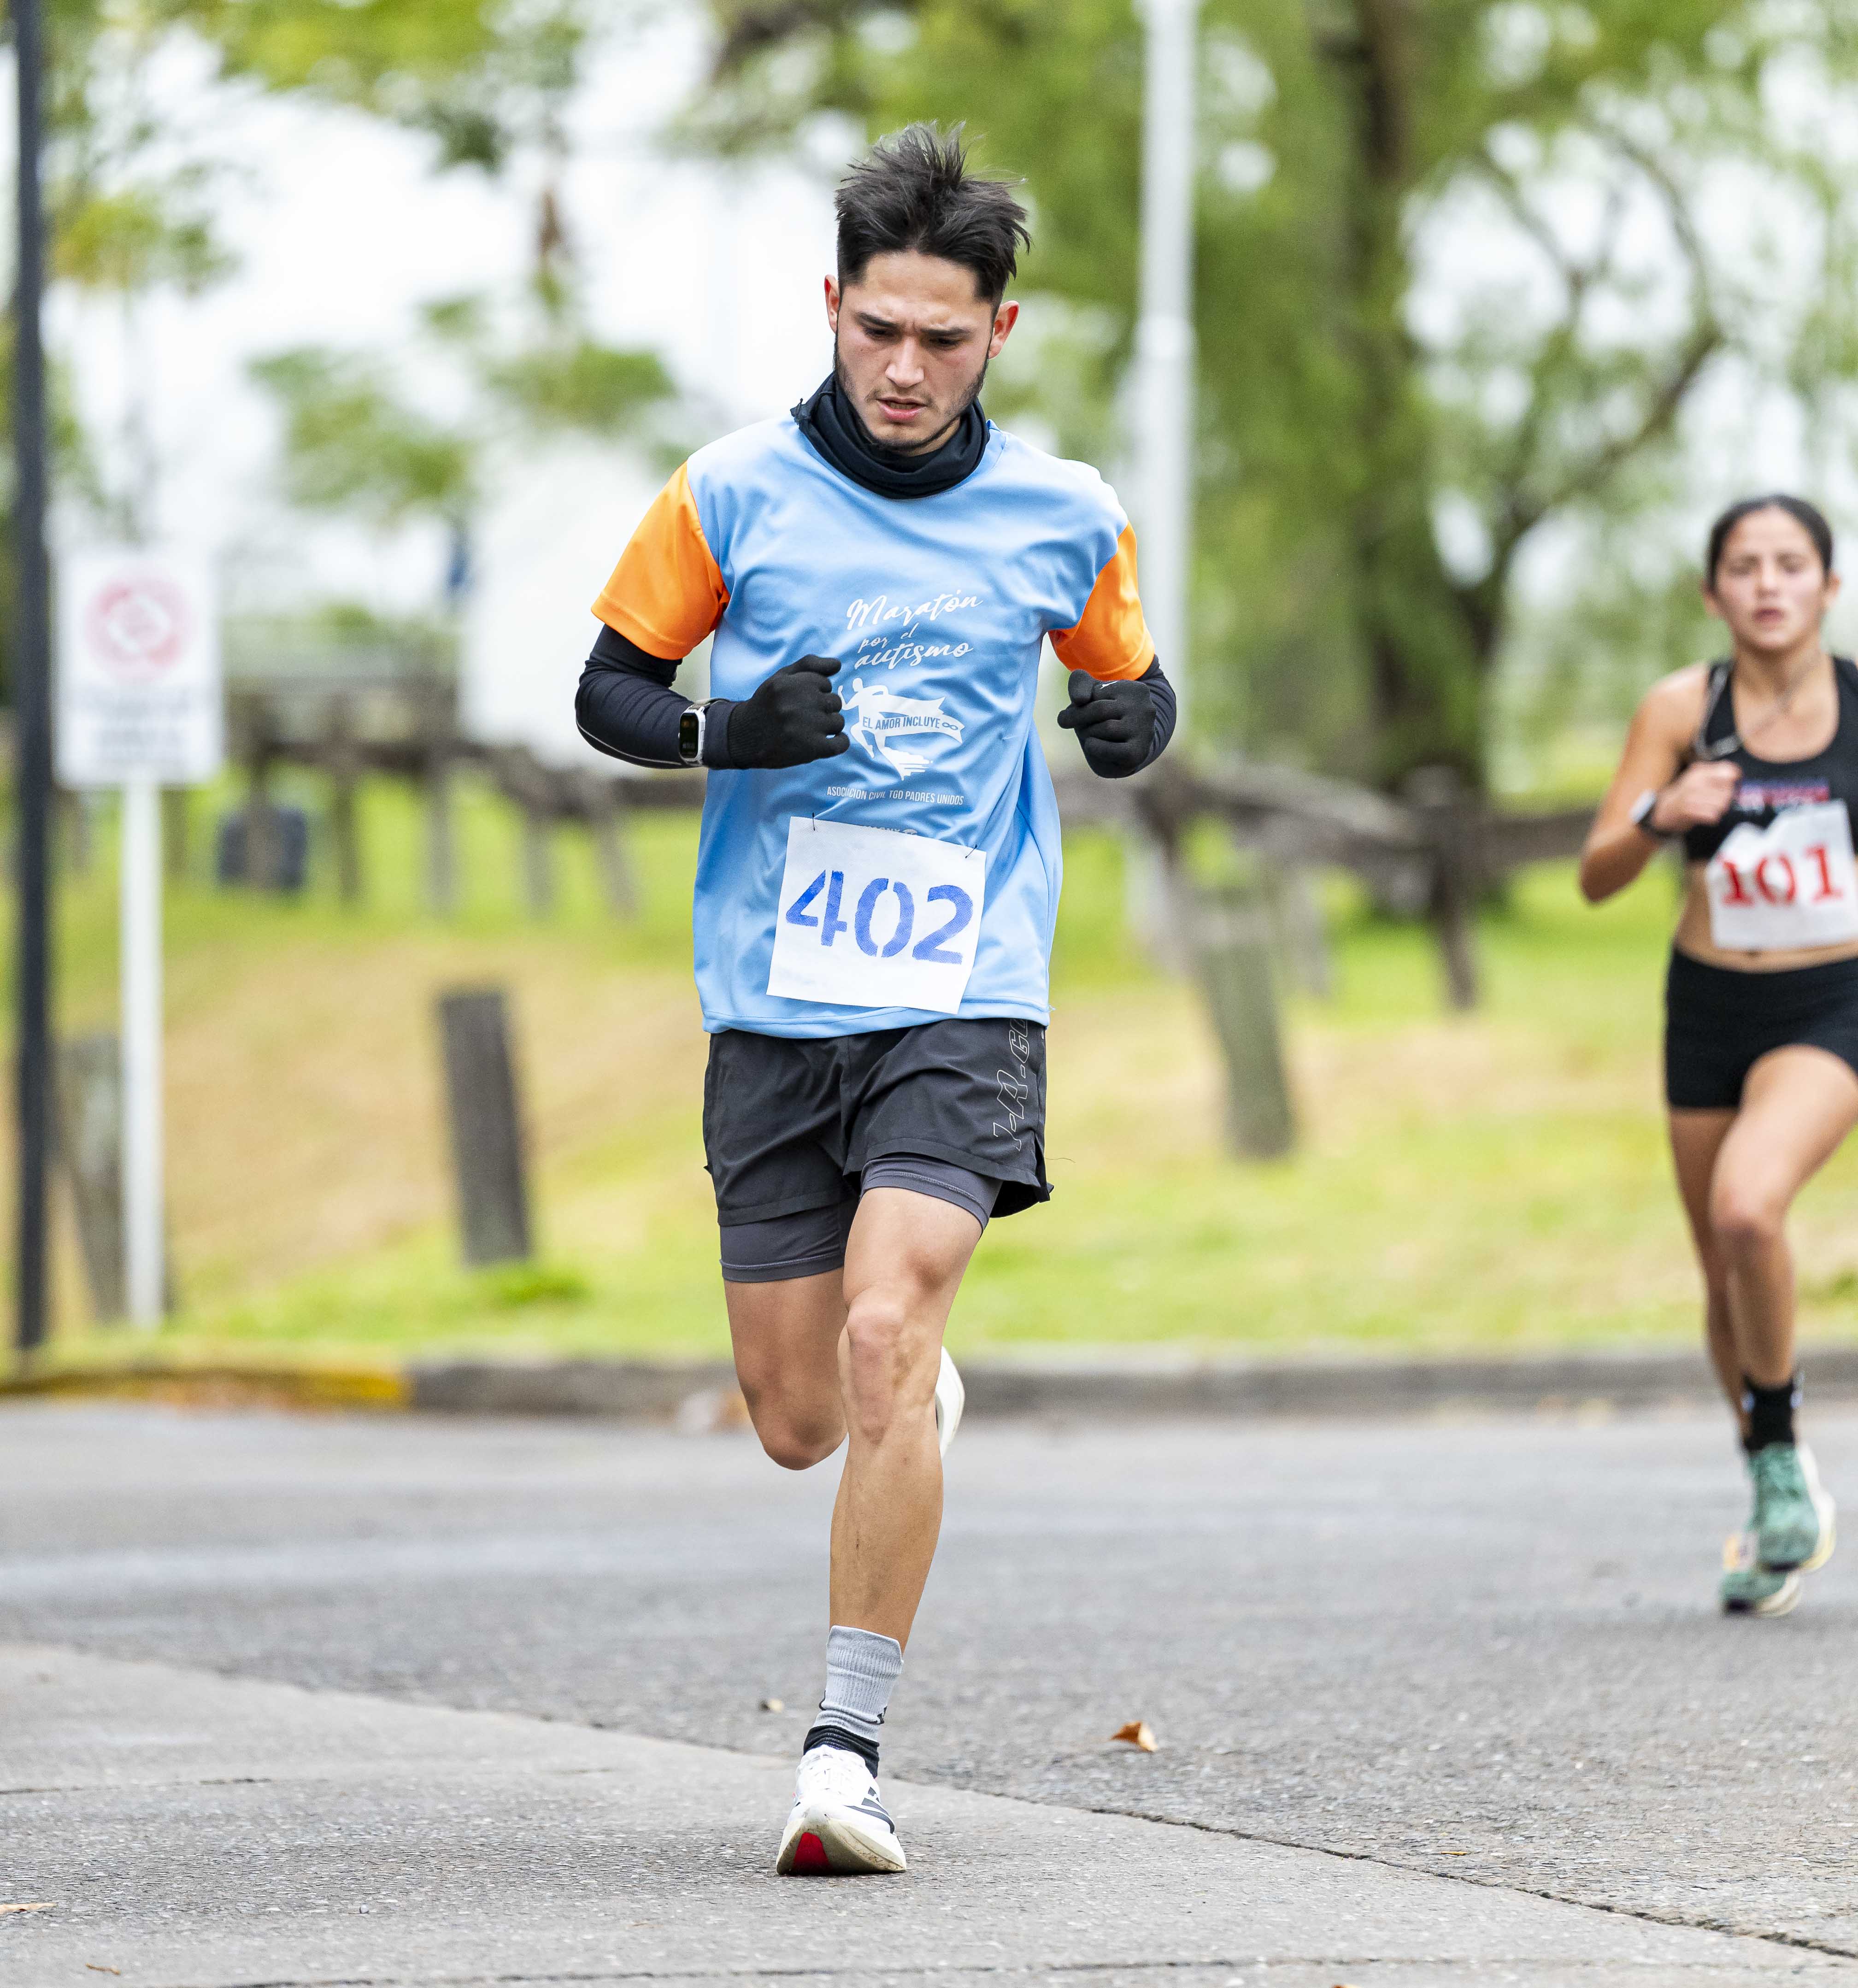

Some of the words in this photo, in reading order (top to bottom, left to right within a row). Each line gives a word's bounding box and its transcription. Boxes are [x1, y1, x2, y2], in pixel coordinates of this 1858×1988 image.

[847, 590, 983, 630] Maratón
[858, 636, 889, 653] por
[900, 623, 919, 640] el
[854, 642, 974, 670] autismo
[863, 717, 873, 729] EL
[875, 718, 900, 729] AMOR
[903, 716, 941, 729] INCLUYE
[869, 791, 885, 800] CIVIL
[889, 790, 903, 800] TGD
[905, 791, 935, 803] PADRES
[937, 794, 964, 805] UNIDOS
[1716, 843, 1844, 907] 101
[786, 870, 973, 965] 402
